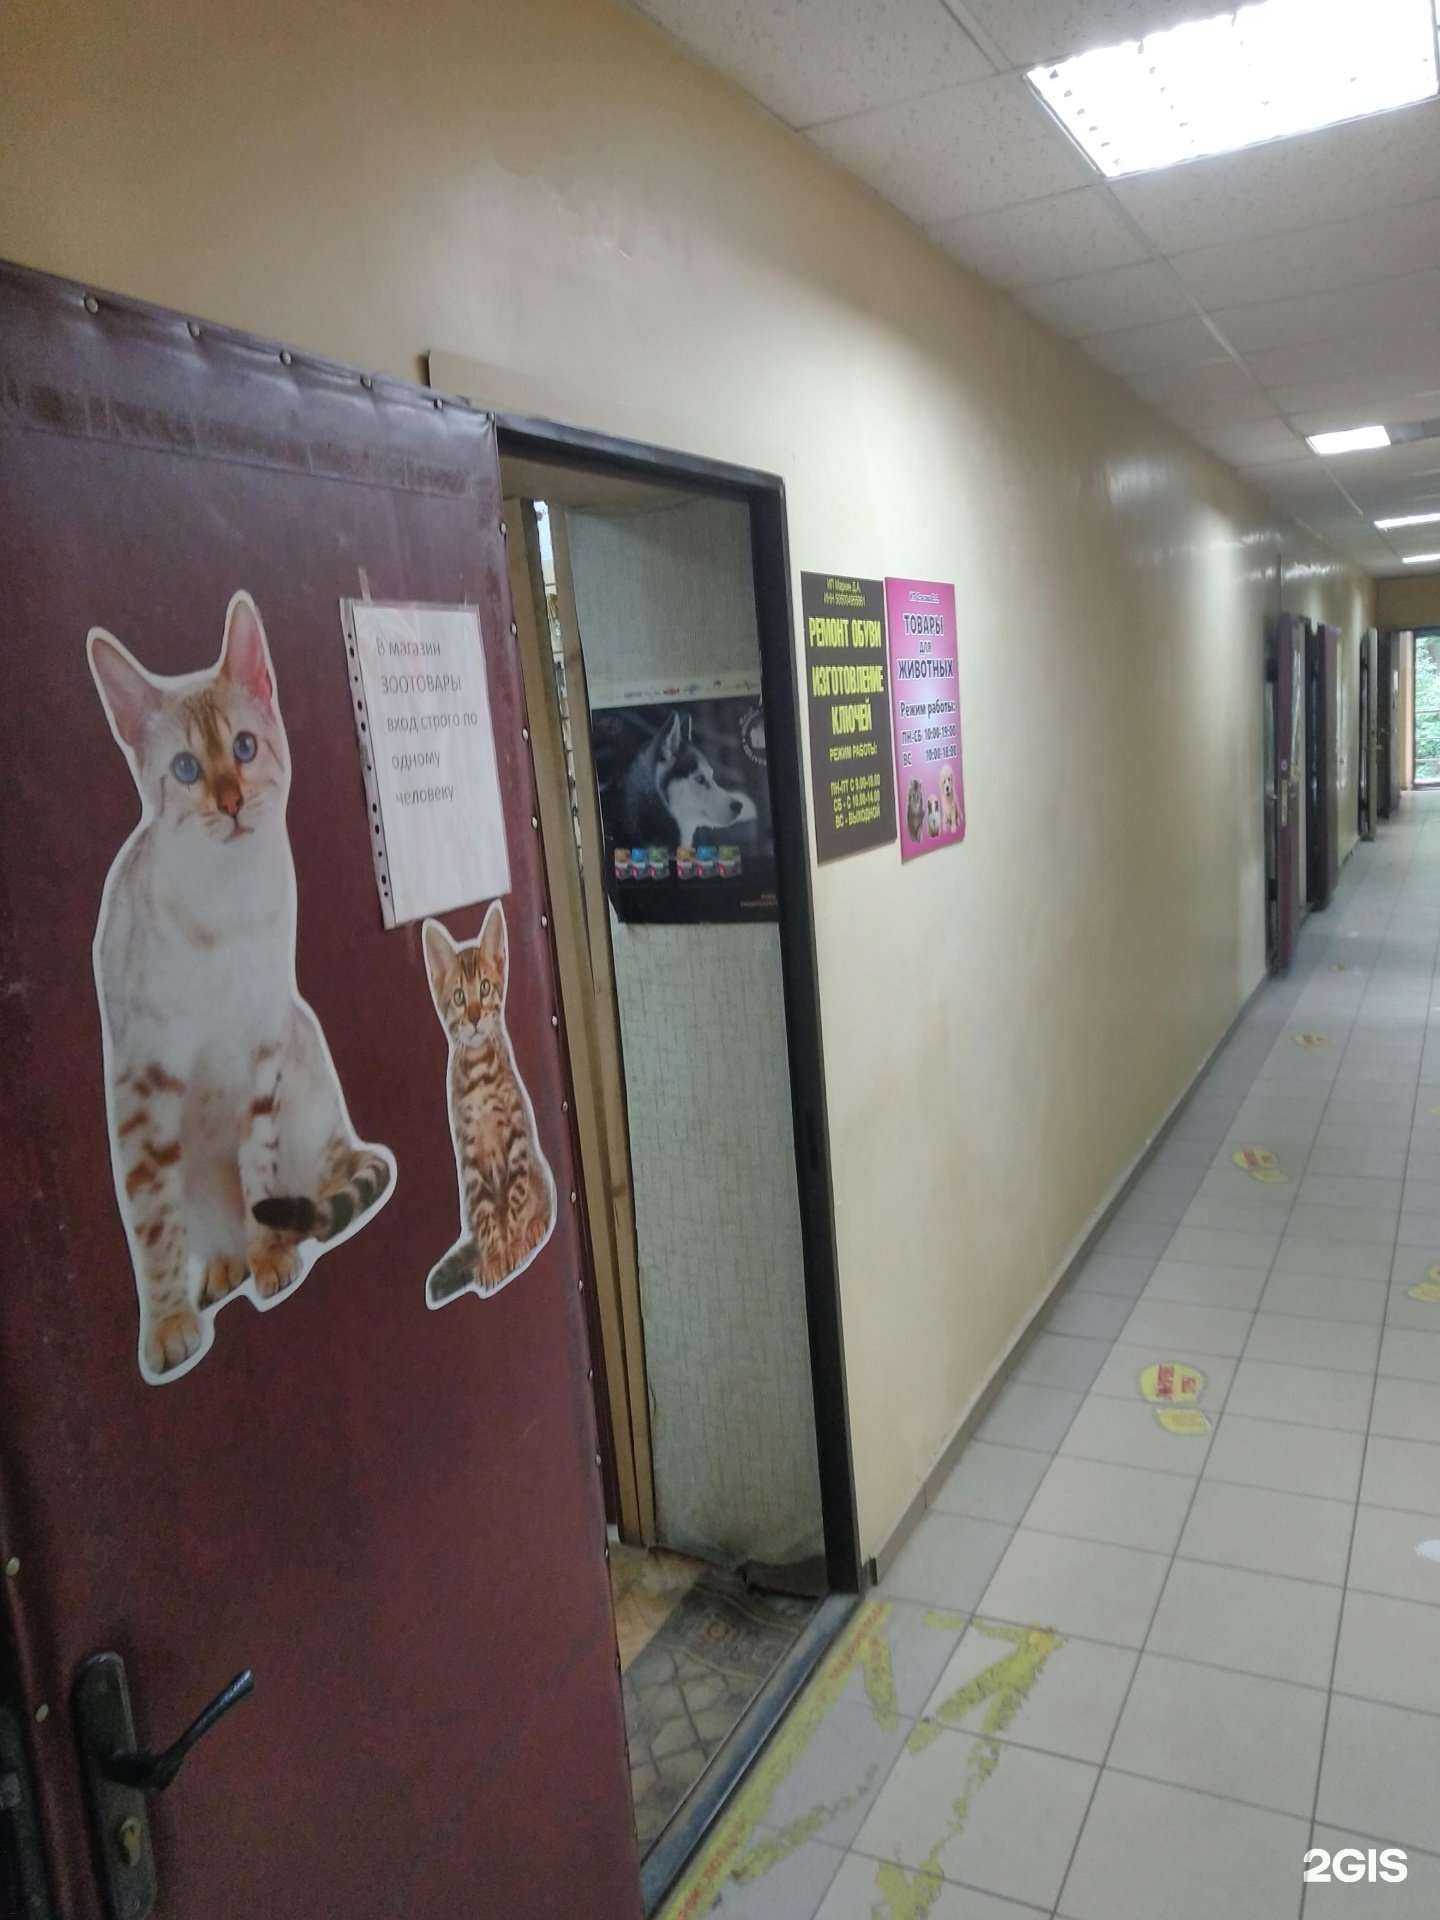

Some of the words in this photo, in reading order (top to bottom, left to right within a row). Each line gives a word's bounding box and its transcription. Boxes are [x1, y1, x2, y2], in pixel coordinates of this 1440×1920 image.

[808, 617, 849, 648] РЕМОНТ
[851, 619, 882, 648] ОБУВИ
[903, 614, 944, 635] ТОВАРЫ
[376, 638, 386, 657] В
[388, 639, 441, 658] магазин
[898, 658, 954, 680] ЖИВОТНЫХ
[381, 674, 462, 695] ЗООТОВАРЫ
[812, 665, 884, 697] ИЗГОТОВЛЕНИЕ
[832, 698, 872, 734] КЛЮЧЕЙ
[900, 701, 926, 717] Режим
[387, 716, 418, 735] вход
[421, 716, 460, 732] строго
[463, 713, 478, 727] по
[391, 752, 441, 769] одному
[829, 745, 851, 762] РЕЖИМ
[903, 752, 912, 767] ВС
[395, 789, 454, 808] человеку
[835, 814, 844, 829] ВС
